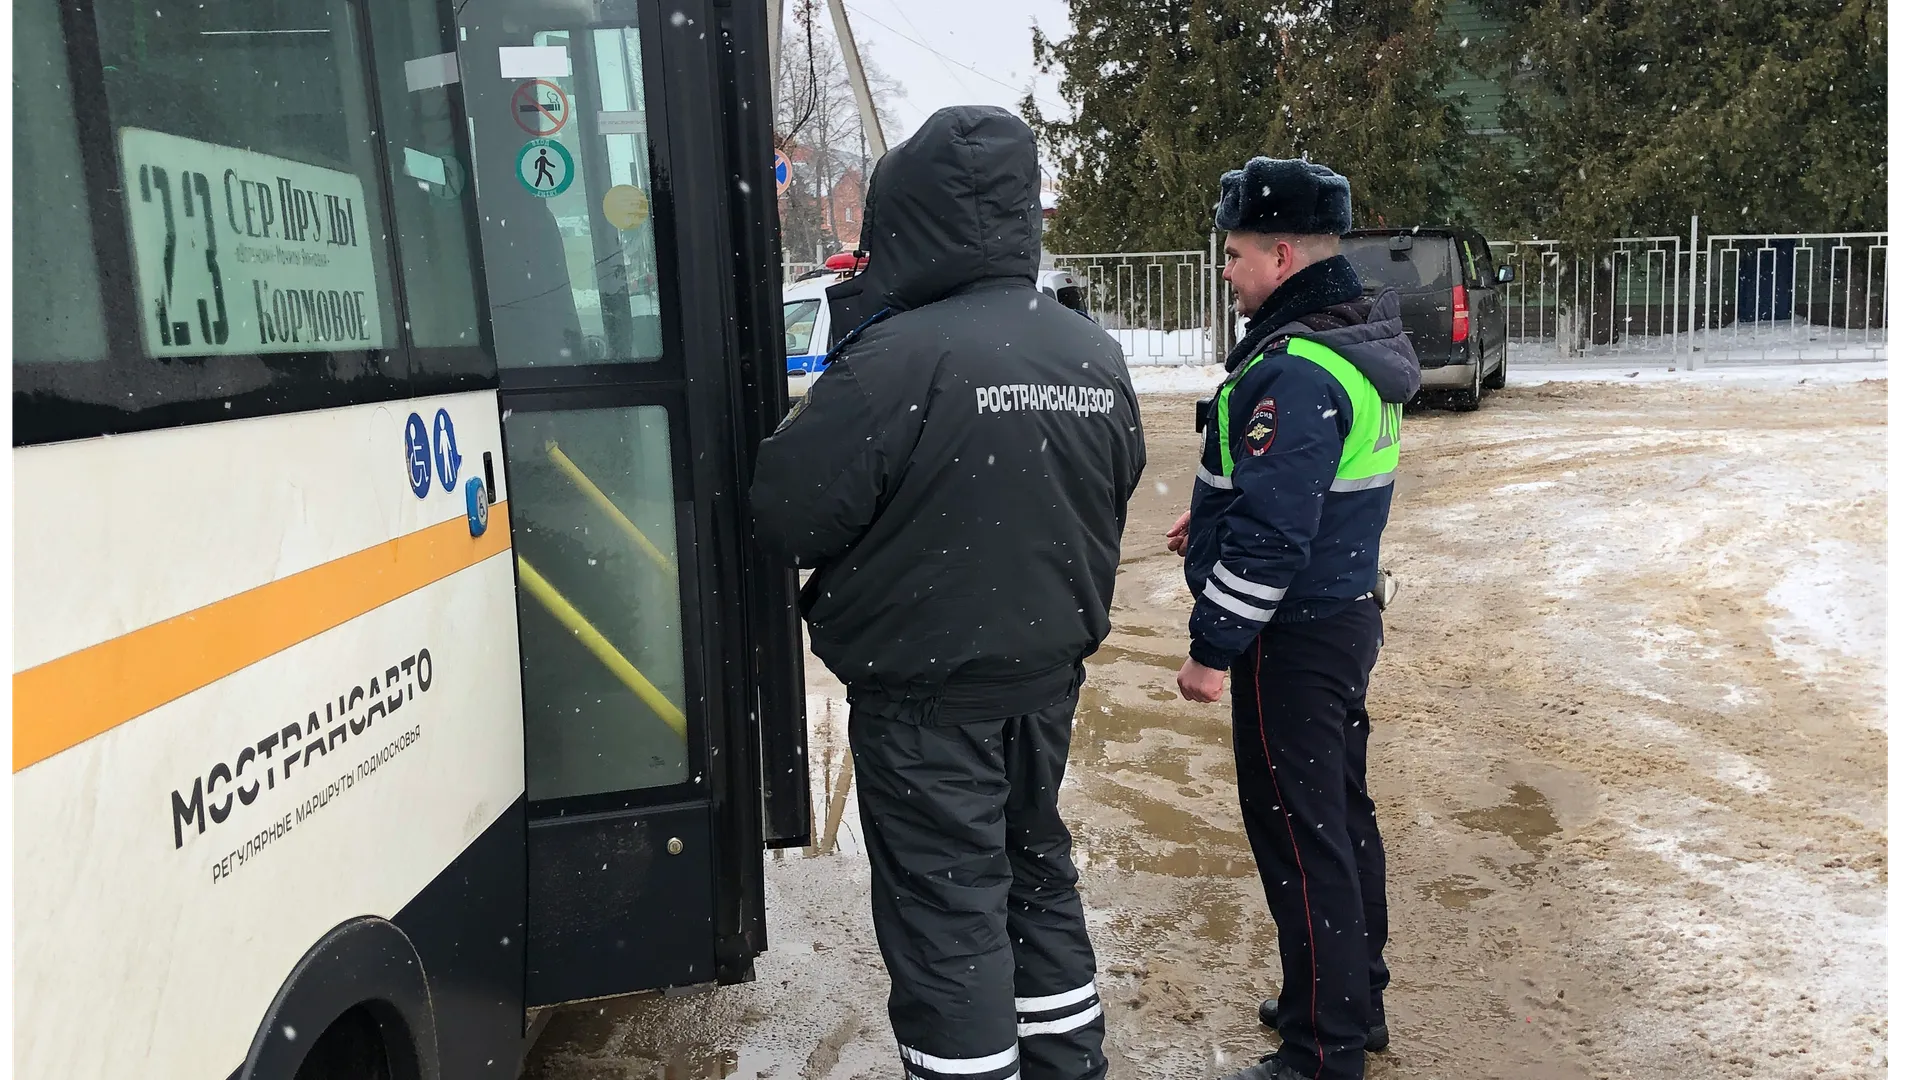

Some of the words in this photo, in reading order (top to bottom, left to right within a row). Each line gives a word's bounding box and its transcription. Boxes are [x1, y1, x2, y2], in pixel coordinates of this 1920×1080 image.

[139, 163, 230, 346] 23
[975, 383, 1115, 418] РОСТРАНСНАДЗОР
[171, 647, 433, 850] МОСТРАНСАВТО
[212, 812, 293, 884] РЕГУЛЯРНЫЕ
[295, 769, 355, 825] МАРШРУТЫ
[357, 724, 421, 782] ПОДМОСКОВЬЯ
